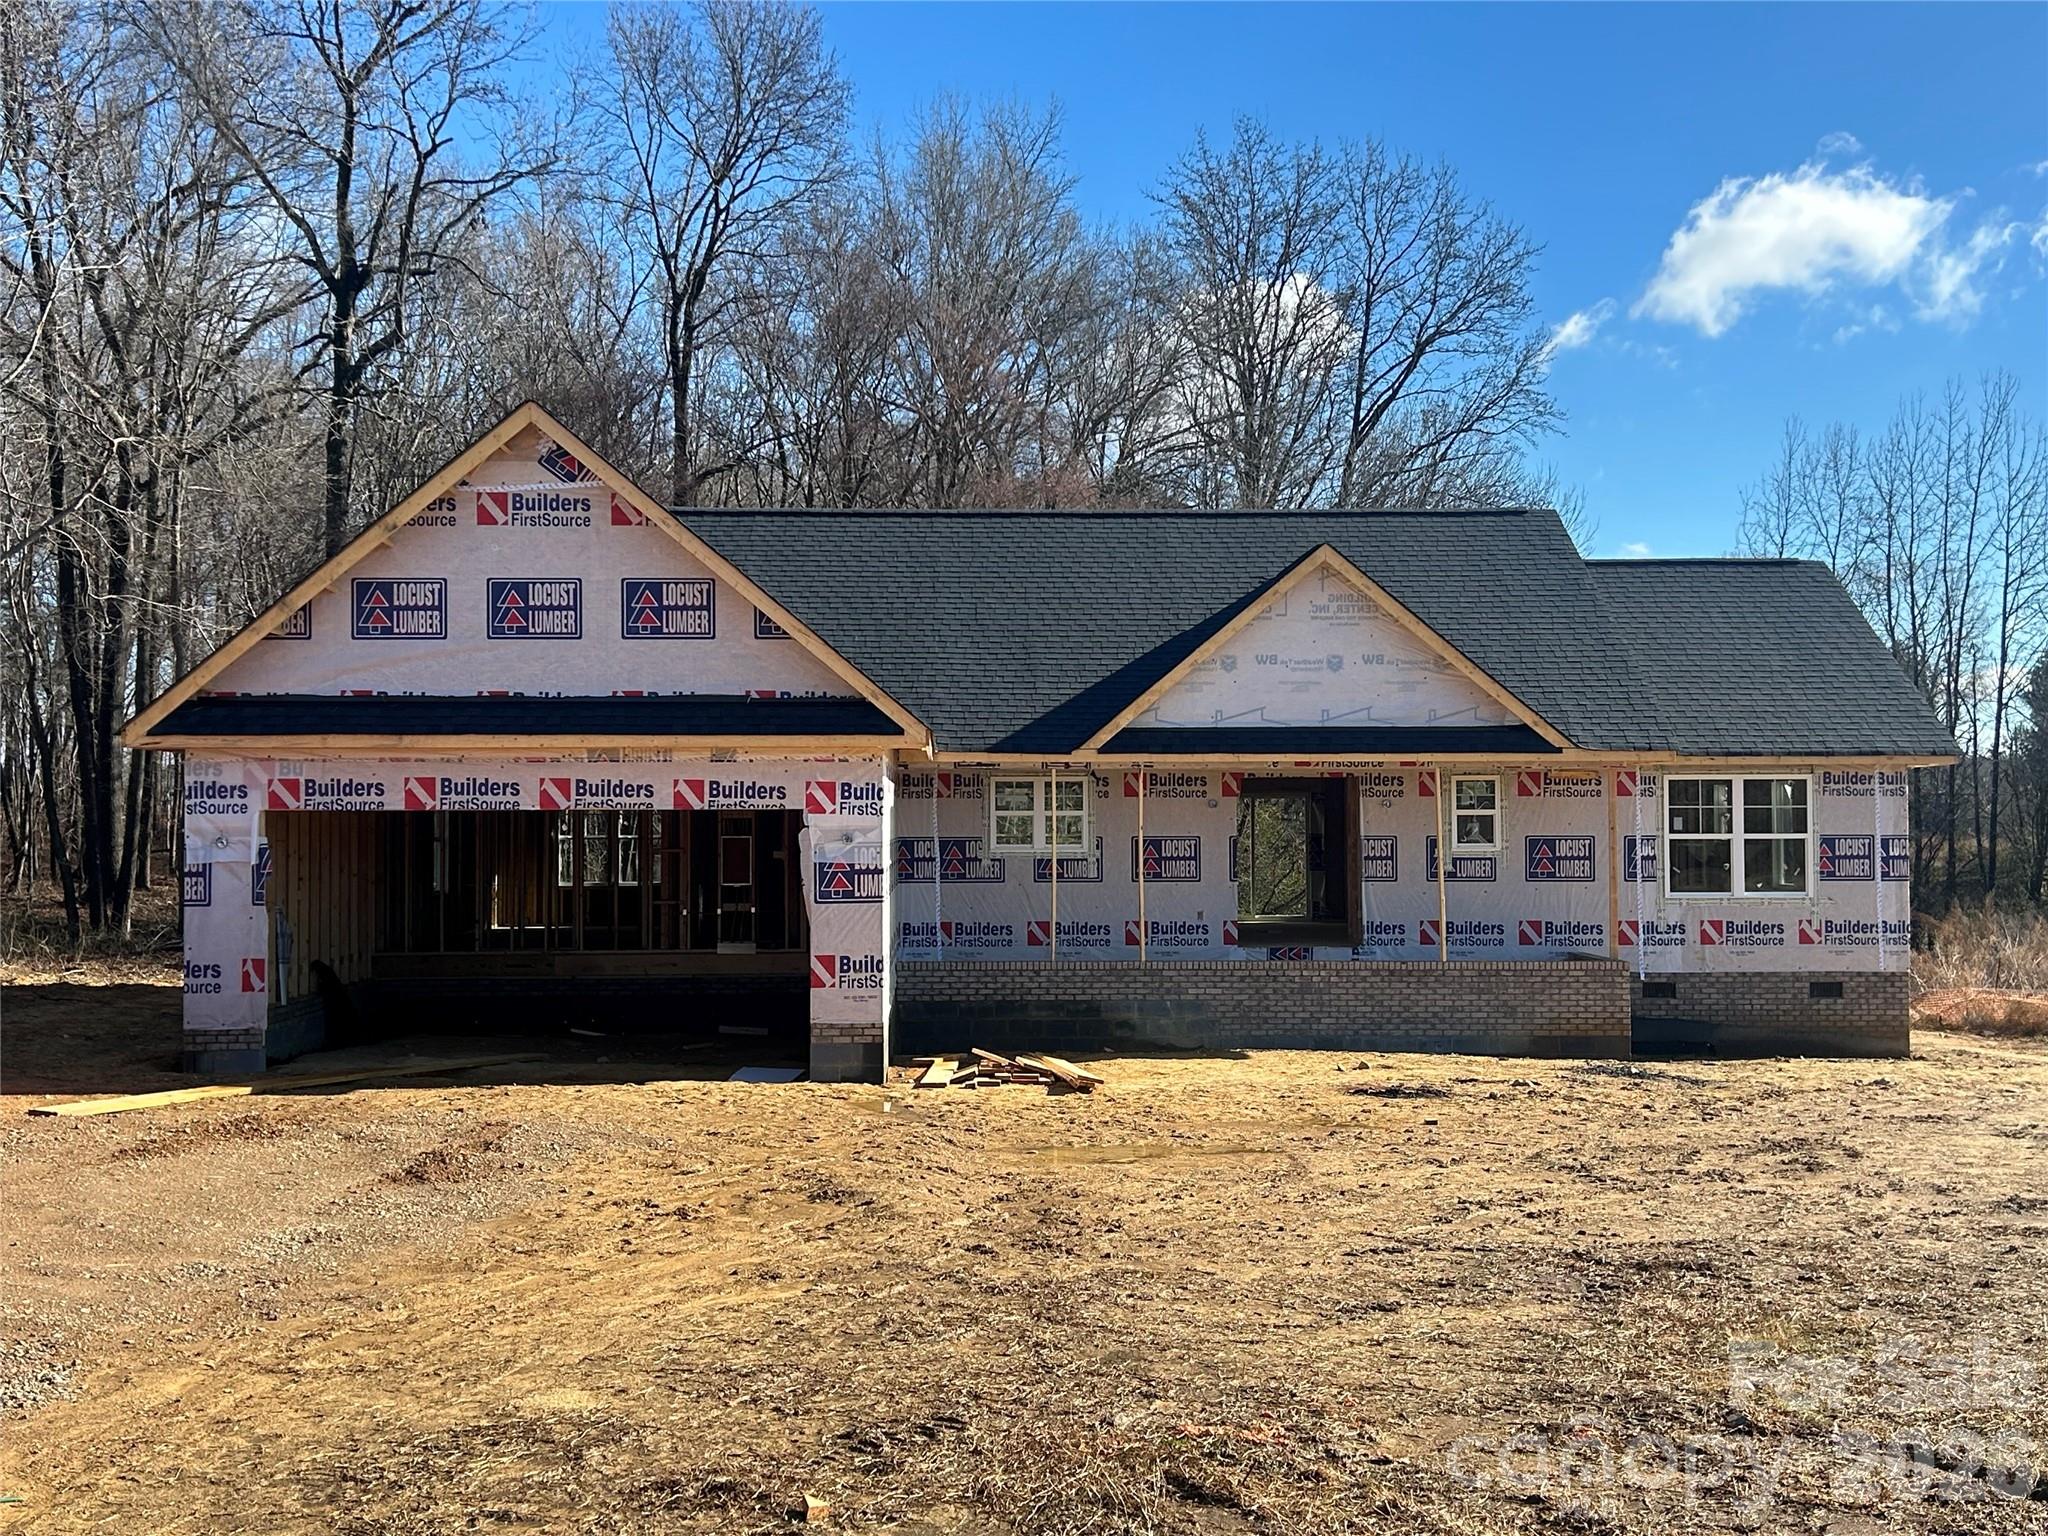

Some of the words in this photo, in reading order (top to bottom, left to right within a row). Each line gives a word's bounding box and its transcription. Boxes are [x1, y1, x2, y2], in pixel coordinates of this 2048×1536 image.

[512, 493, 591, 512] Builders
[511, 513, 591, 528] FirstSource
[393, 583, 441, 606] LOCUST
[529, 583, 576, 606] LOCUST
[663, 583, 709, 606] LOCUST
[393, 610, 441, 634] LUMBER
[529, 610, 576, 634] LUMBER
[663, 610, 709, 633] LUMBER
[1150, 773, 1208, 787] Builders
[1823, 771, 1877, 785] Builder
[304, 779, 385, 798] Builders
[440, 777, 521, 797] Builders
[575, 779, 654, 798] Builders
[708, 780, 787, 800] Builders
[1149, 787, 1208, 798] FirstSource
[1543, 786, 1602, 798] FirstSource
[439, 797, 521, 810] FirstSource
[1161, 840, 1196, 857] LOCUST
[1556, 839, 1590, 857] LOCUST
[1835, 839, 1870, 856] LOCUST
[1161, 860, 1196, 878] LUMBER
[1456, 860, 1492, 877] LUMBER
[1556, 860, 1590, 877] LUMBER
[1835, 859, 1871, 877] LUMBER
[954, 922, 1013, 936] Builders
[1055, 921, 1111, 936] Builders
[1151, 921, 1209, 936] Builders
[1446, 921, 1505, 935] Builders
[1545, 921, 1604, 935] Builders
[1725, 920, 1785, 934] Builders
[954, 936, 1013, 948] FirstSource
[1055, 936, 1111, 947] FirstSource
[1150, 936, 1209, 947] FirstSource
[1446, 935, 1505, 947] FirstSource
[1544, 935, 1604, 947] FirstSource
[1725, 935, 1785, 946] FirstSource
